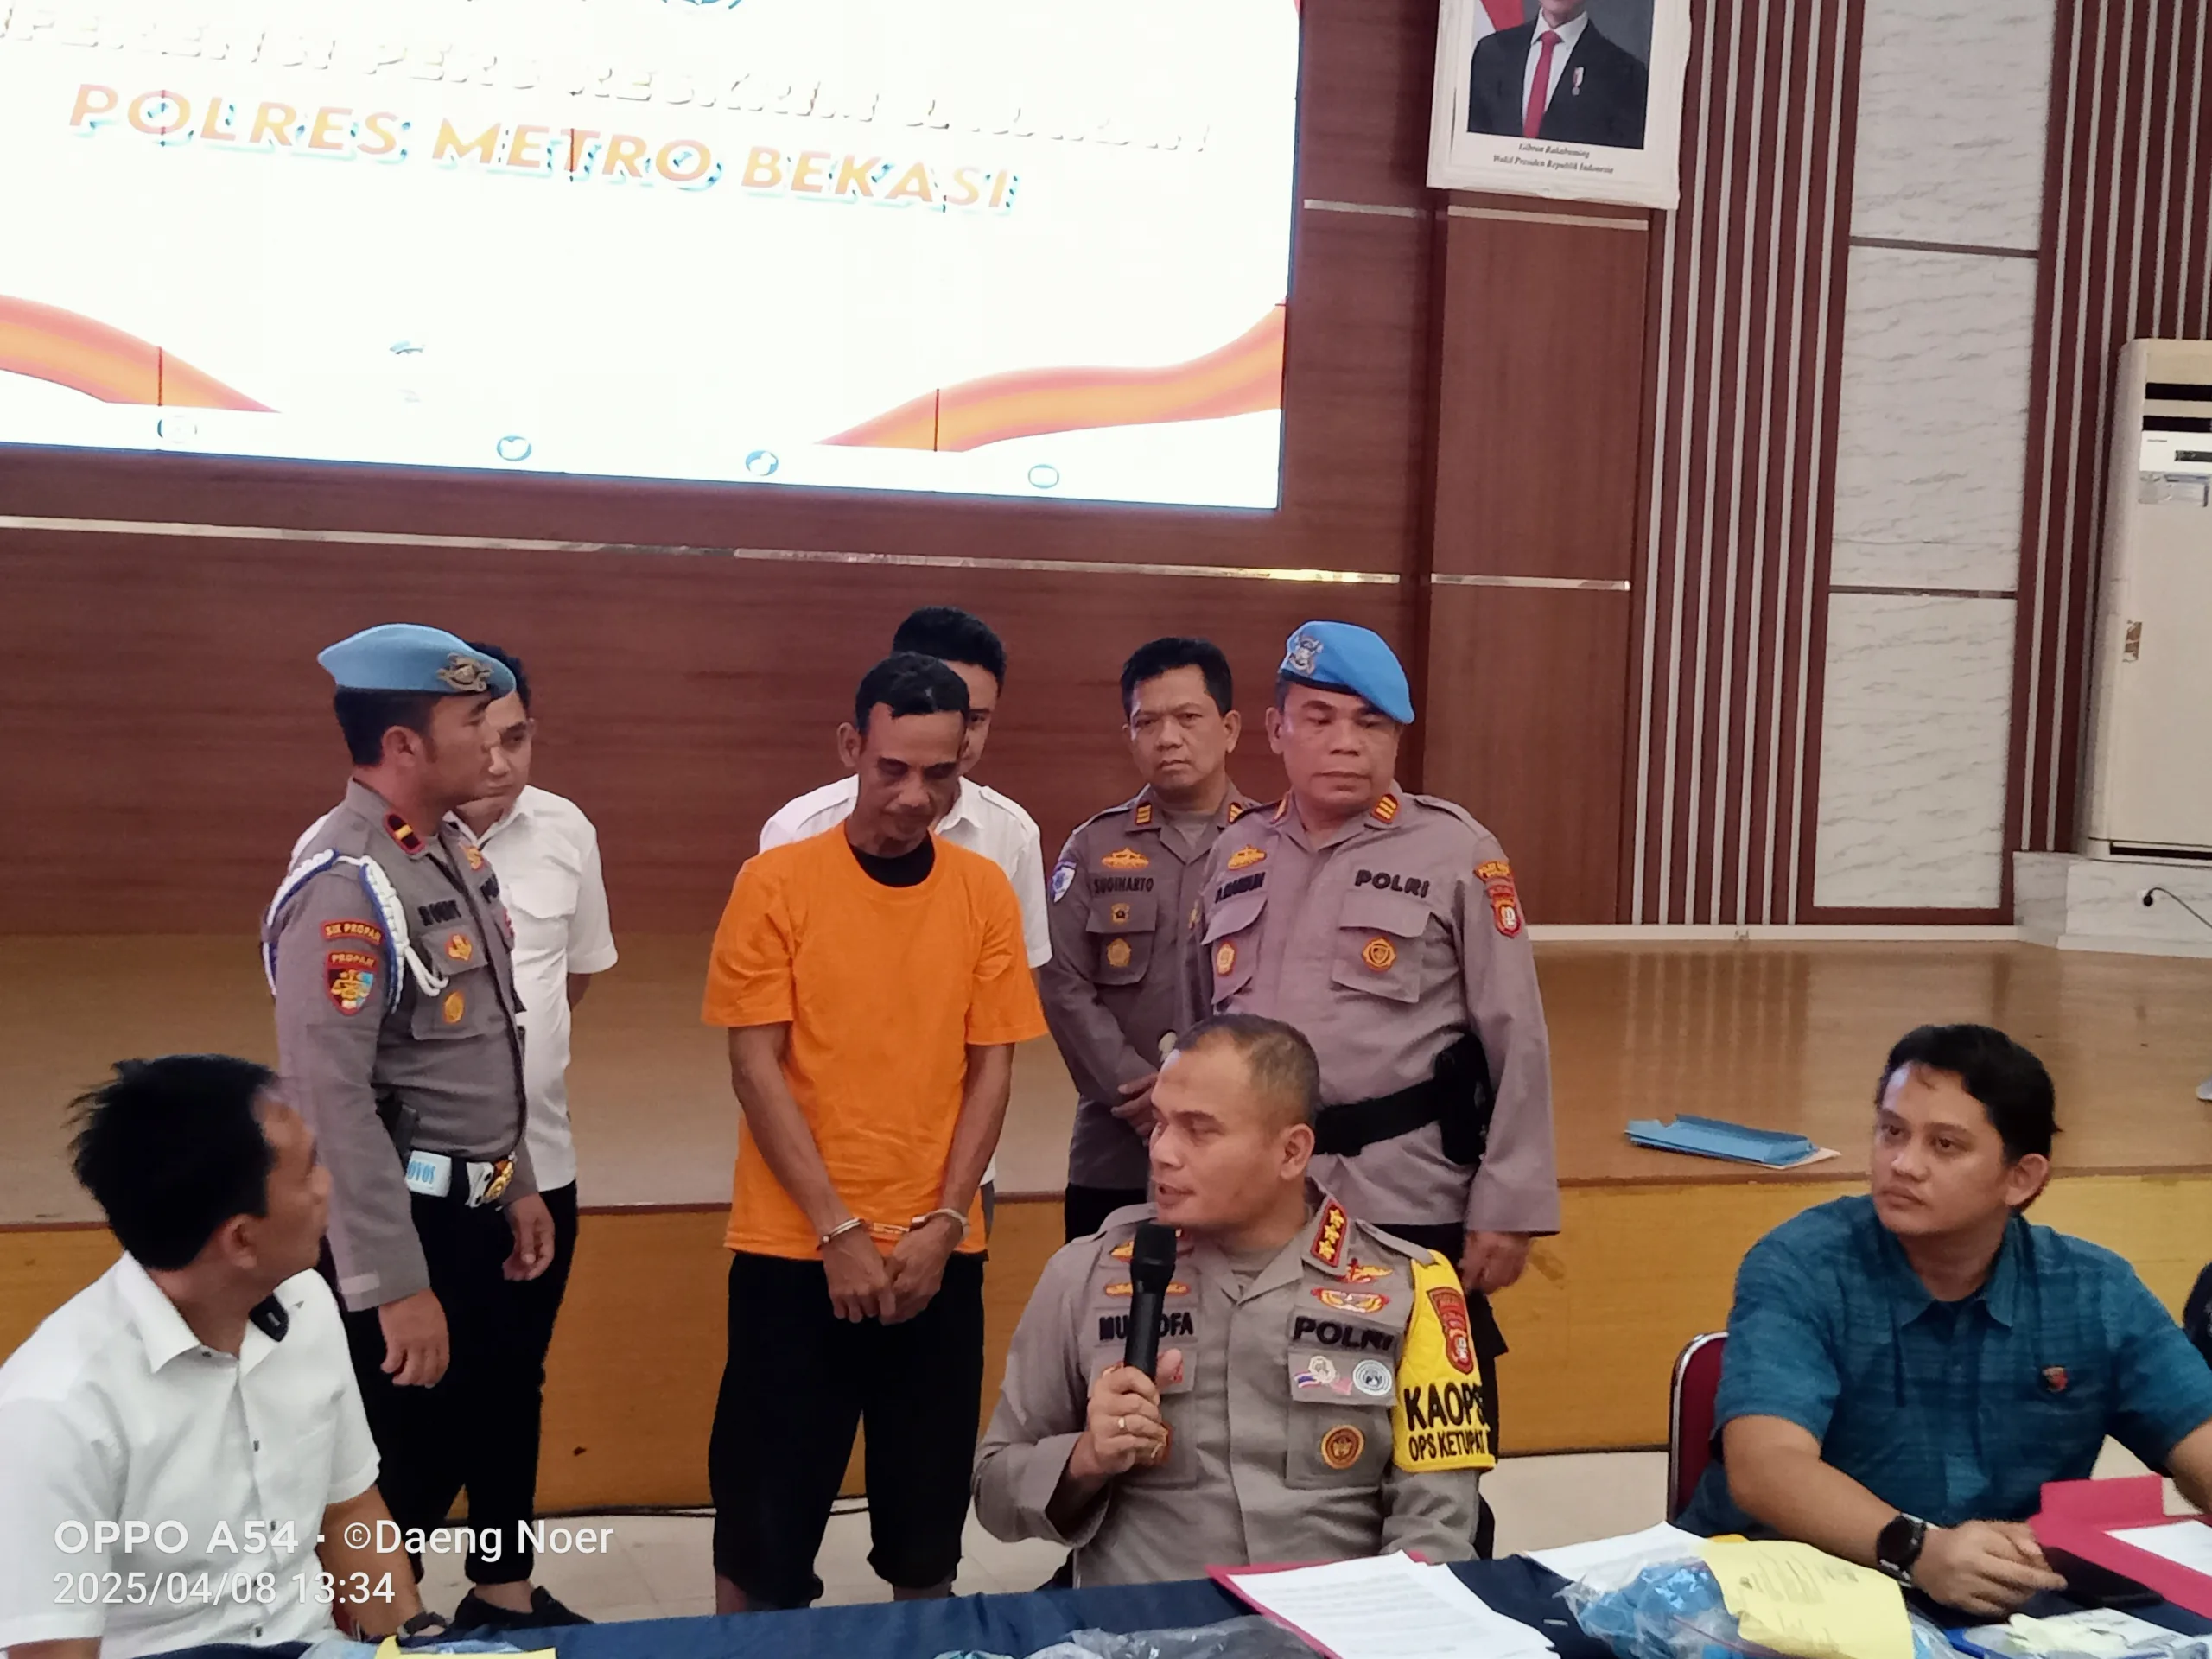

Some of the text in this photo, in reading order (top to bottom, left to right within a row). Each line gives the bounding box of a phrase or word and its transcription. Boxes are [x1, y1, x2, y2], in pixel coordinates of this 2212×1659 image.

[68, 83, 1010, 211] POLRES METRO BEKASI
[1354, 869, 1431, 899] POLRI
[1098, 1312, 1194, 1341] MUOFA
[1293, 1316, 1395, 1351] POLRI
[1408, 1433, 1437, 1463] OPS
